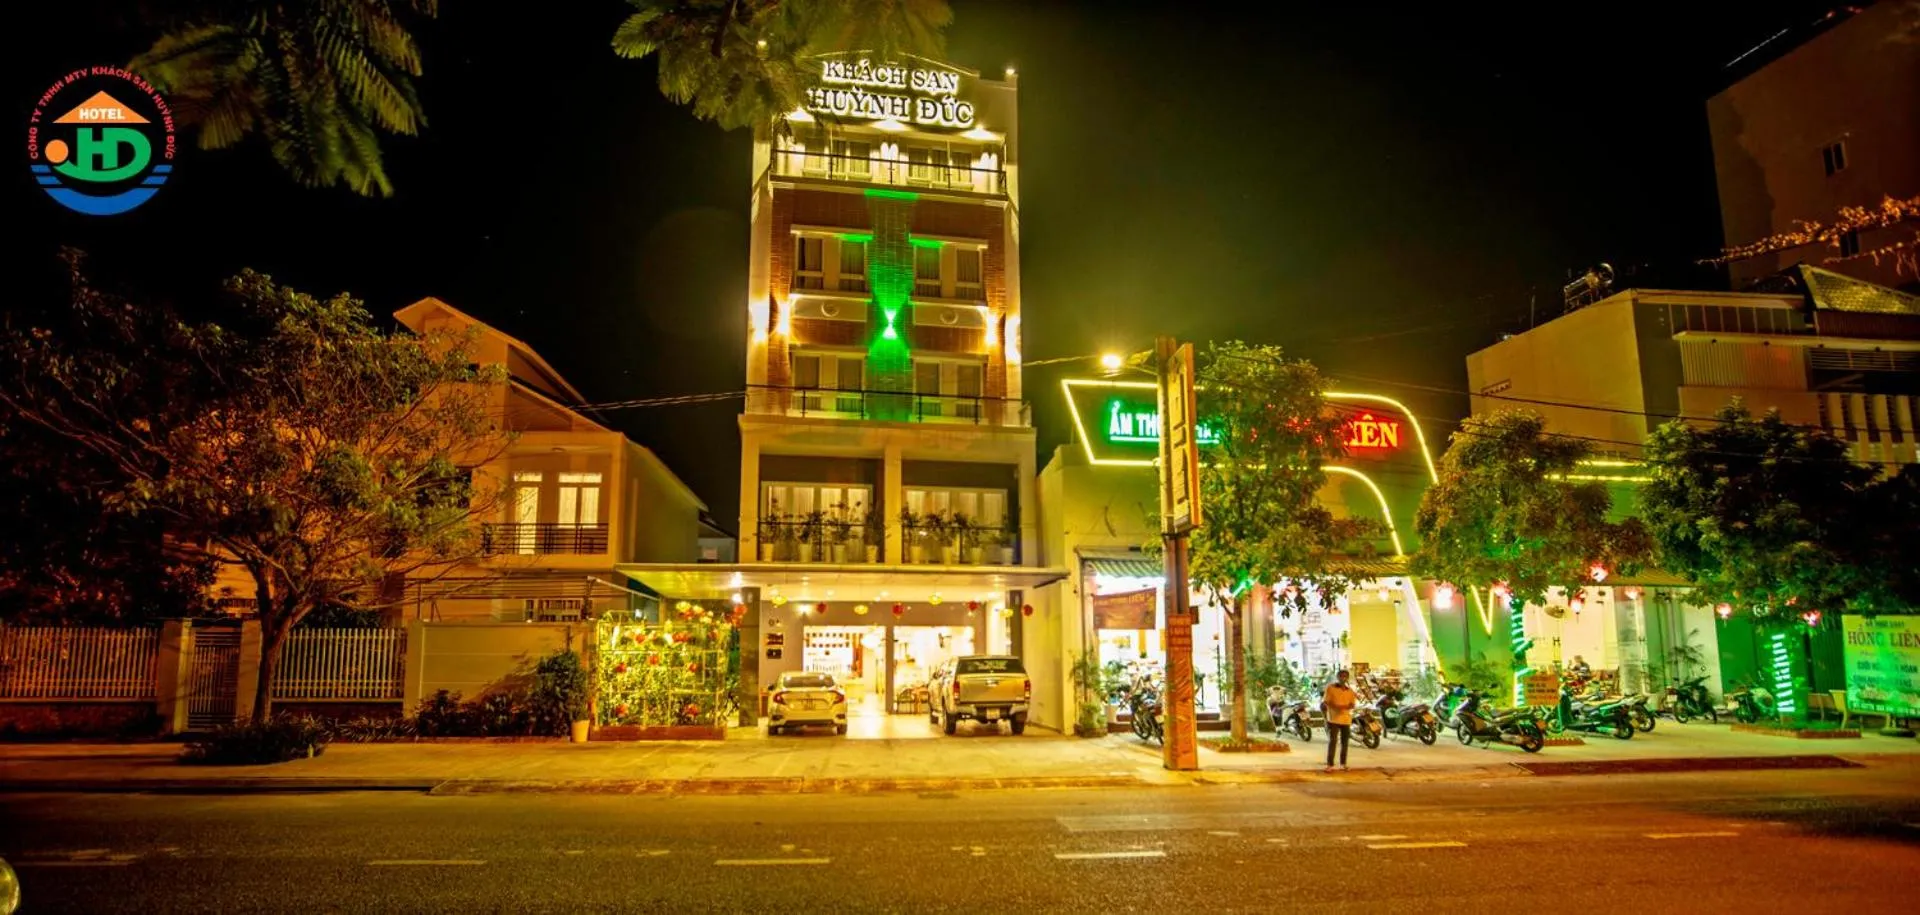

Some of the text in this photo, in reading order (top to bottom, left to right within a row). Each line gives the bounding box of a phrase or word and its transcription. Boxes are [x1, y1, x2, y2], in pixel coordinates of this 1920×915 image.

[823, 59, 958, 95] KHÁCH SẠN
[808, 86, 974, 125] HUỲNH ĐỨC
[1109, 401, 1133, 435] ẨM
[1344, 414, 1399, 448] IÊN
